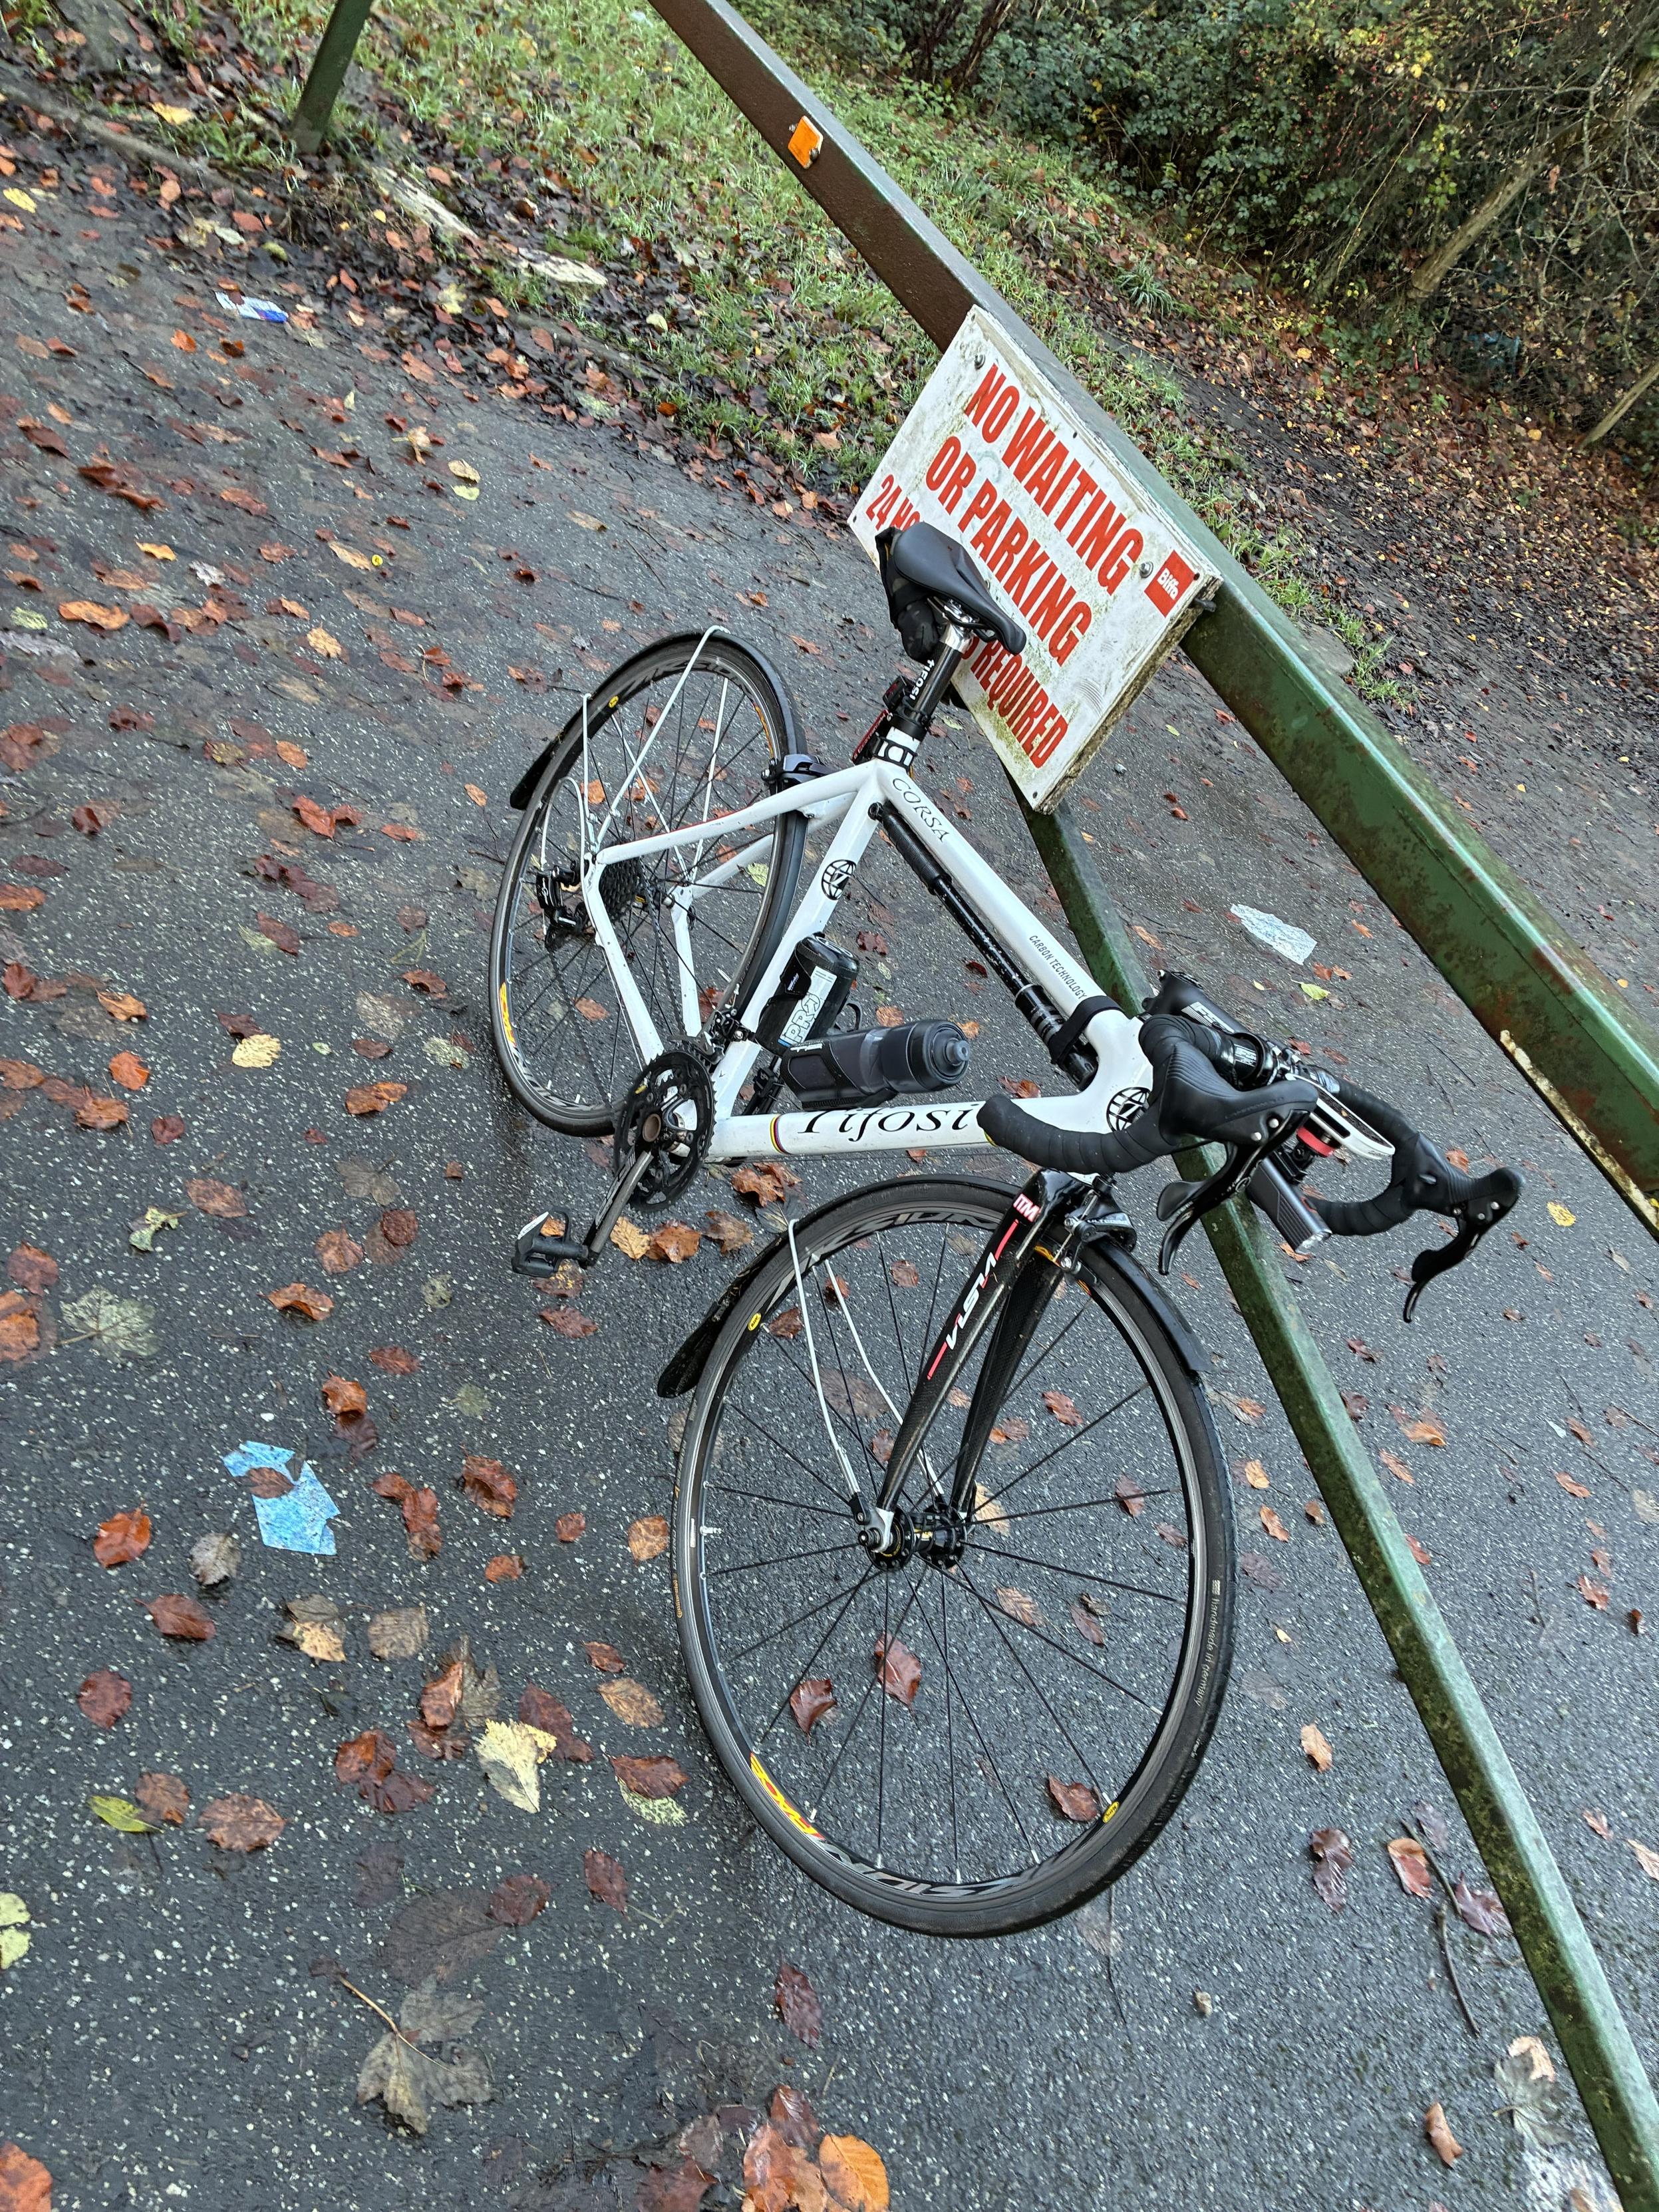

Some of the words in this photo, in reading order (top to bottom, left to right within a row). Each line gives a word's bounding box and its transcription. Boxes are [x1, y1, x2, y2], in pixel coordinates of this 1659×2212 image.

[965, 364, 1020, 443] NO
[1002, 406, 1144, 595] WAITING
[926, 436, 977, 515] OR
[957, 478, 1092, 665] PARKING
[1156, 567, 1179, 600] Biffa
[865, 474, 903, 531] 24
[971, 639, 1068, 768] REQUIRED
[892, 778, 949, 842] CORSA
[1028, 934, 1055, 963] CARBON
[1048, 957, 1088, 1000] TECHNOLOGY
[798, 1102, 979, 1142] Tifosi
[1013, 1193, 1042, 1222] ITM
